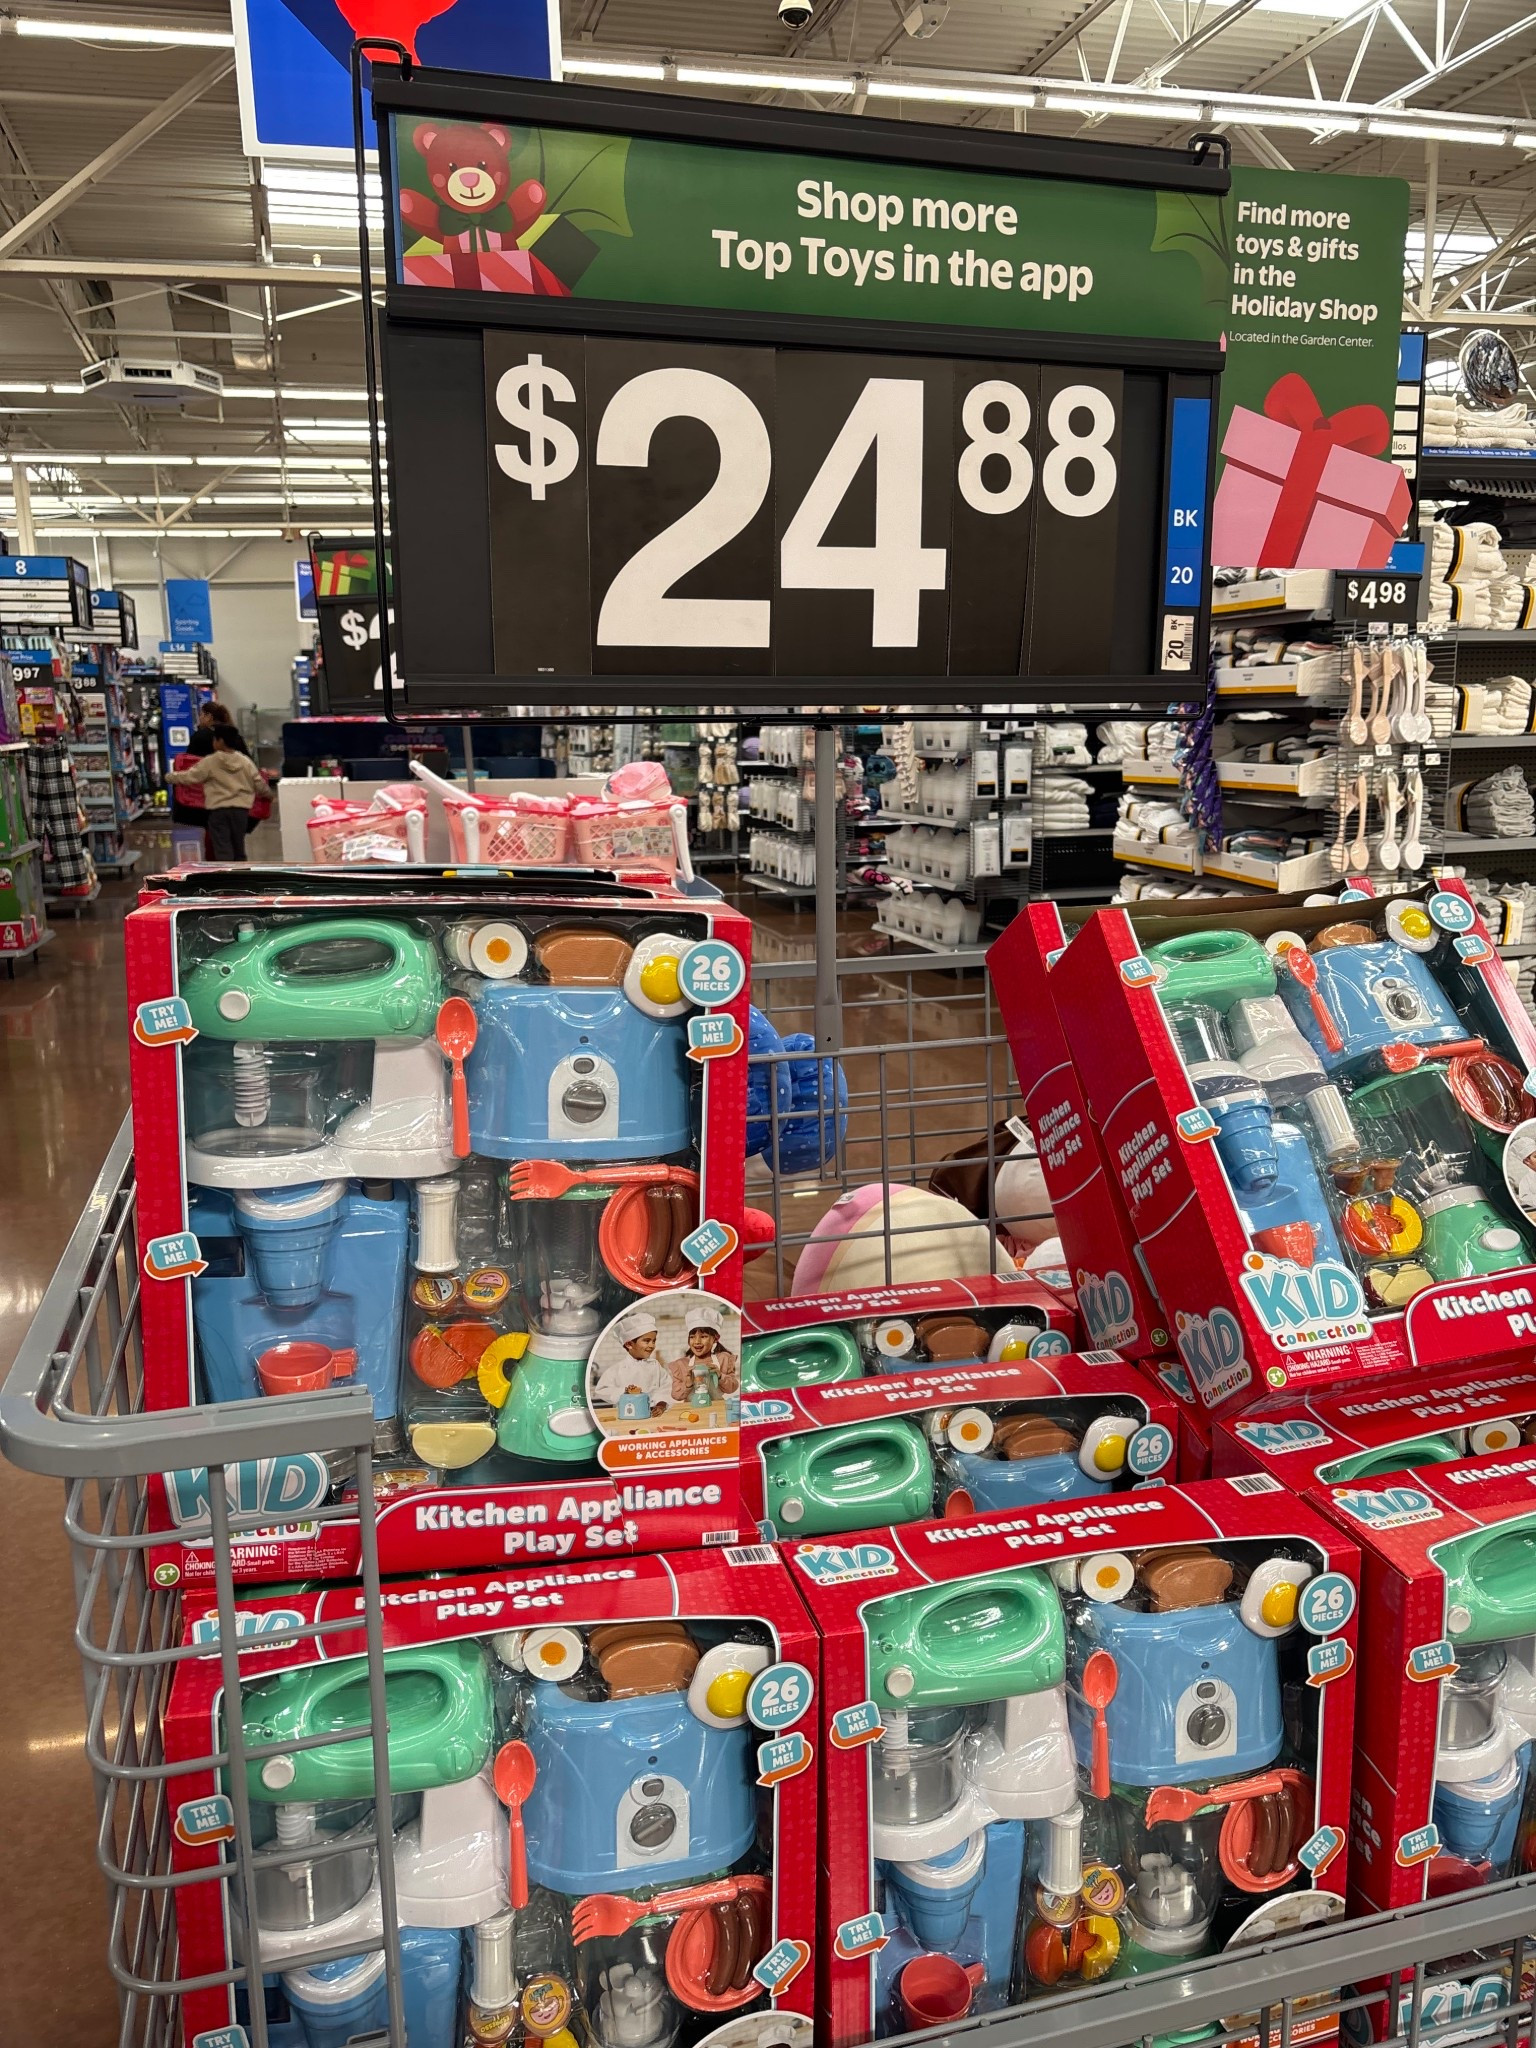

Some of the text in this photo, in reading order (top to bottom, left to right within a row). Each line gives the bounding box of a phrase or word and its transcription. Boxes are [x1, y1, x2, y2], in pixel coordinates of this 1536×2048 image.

[797, 180, 1018, 235] Shop more
[1238, 202, 1350, 229] Find more
[1236, 233, 1359, 262] toys & gifts
[712, 229, 1093, 301] Top Toys in the app
[1233, 263, 1296, 287] in the
[1231, 294, 1378, 325] Holiday Shop
[1229, 331, 1374, 347] Located in the Garden Center.
[1173, 509, 1198, 527] BK
[15, 560, 27, 575] 8
[1170, 566, 1193, 584] 20
[1348, 580, 1406, 609] $498
[1168, 619, 1185, 660] 20 BK
[1436, 901, 1464, 918] 26
[1443, 915, 1468, 923] PIECES
[1461, 939, 1477, 948] TRY
[1466, 946, 1480, 955] ME!
[692, 955, 731, 981] 26
[1127, 961, 1143, 971] TRY
[1133, 968, 1148, 978] ME!
[693, 982, 730, 991] PIECES
[149, 1005, 174, 1019] TRY
[154, 1016, 178, 1030] ME!
[700, 1021, 723, 1033] TRY
[703, 1032, 724, 1044] ME!
[1038, 1100, 1071, 1134] Kitchen
[1184, 1113, 1201, 1124] TRY
[1039, 1113, 1081, 1154] Appliance
[1190, 1121, 1206, 1132] ME!
[1118, 1120, 1157, 1165] Kitchen
[1047, 1134, 1083, 1171] Play Set
[1120, 1133, 1169, 1188] Appliance
[1131, 1157, 1173, 1204] Play Set
[159, 1239, 184, 1254] TRY
[691, 1228, 712, 1249] TRY
[700, 1237, 720, 1258] ME!
[164, 1251, 188, 1265] ME!
[764, 1285, 942, 1312] Kitchen Appliance
[822, 1298, 902, 1313] Play Set
[1080, 1275, 1131, 1337] KID
[1246, 1269, 1358, 1329] KID
[1432, 1287, 1534, 1321] Kitchen
[1096, 1326, 1136, 1350] Connection
[1154, 1331, 1165, 1343] 3+
[1276, 1323, 1367, 1347] Connection
[1038, 1339, 1062, 1355] 26
[1181, 1311, 1240, 1387] KID
[1303, 1345, 1353, 1361] WARNING:
[820, 1367, 1022, 1399] Kitchen Appliance
[1270, 1370, 1283, 1382] 3+
[887, 1382, 977, 1402] Play Set
[1203, 1367, 1248, 1404] Connection
[1339, 1392, 1430, 1417] Kitchen
[1429, 1374, 1536, 1399] Appliance
[1411, 1394, 1507, 1418] Play Set
[1241, 1421, 1320, 1448] KID
[618, 1436, 727, 1452] WORKING APPLIANCES
[645, 1447, 710, 1459] ACCESSORIES
[1137, 1434, 1163, 1457] 26
[1268, 1438, 1330, 1454] Connection
[1137, 1453, 1163, 1466] PIECES
[416, 1484, 721, 1531] Kitchen Appliance
[1340, 1489, 1428, 1521] KID
[924, 1499, 1165, 1544] Kitchen Appliance
[1372, 1510, 1439, 1529] Connection
[504, 1520, 639, 1556] Play Set
[1004, 1523, 1117, 1551] Play Set
[230, 1545, 281, 1559] ARNING:
[799, 1546, 890, 1576] KID
[159, 1568, 176, 1581] 3+
[484, 1568, 636, 1594] Appliance
[819, 1567, 895, 1584] Connection
[436, 1591, 564, 1621] Play Set
[1312, 1585, 1344, 1614] 26
[1312, 1610, 1344, 1623] PIECES
[1318, 1645, 1338, 1660] TRY
[1420, 1646, 1443, 1659] TRY
[1320, 1656, 1338, 1670] ME!
[1424, 1655, 1444, 1669] ME!
[762, 1676, 800, 1708] 26
[762, 1702, 799, 1718] PIECES
[844, 1709, 866, 1724] TRY
[849, 1719, 869, 1734] ME!
[770, 1741, 794, 1757] TRY
[773, 1752, 794, 1768] ME!
[190, 1803, 216, 1818] TRY
[196, 1814, 220, 1829] ME!
[1307, 1835, 1325, 1854] TRY
[1408, 1831, 1427, 1845] TRY
[1411, 1840, 1428, 1854] ME!
[1314, 1841, 1331, 1861] ME!
[848, 1920, 870, 1935] TRY
[852, 1930, 873, 1945] ME!
[764, 1949, 785, 1971] TRY
[773, 1956, 792, 1978] ME!
[205, 2033, 231, 2047] TRY
